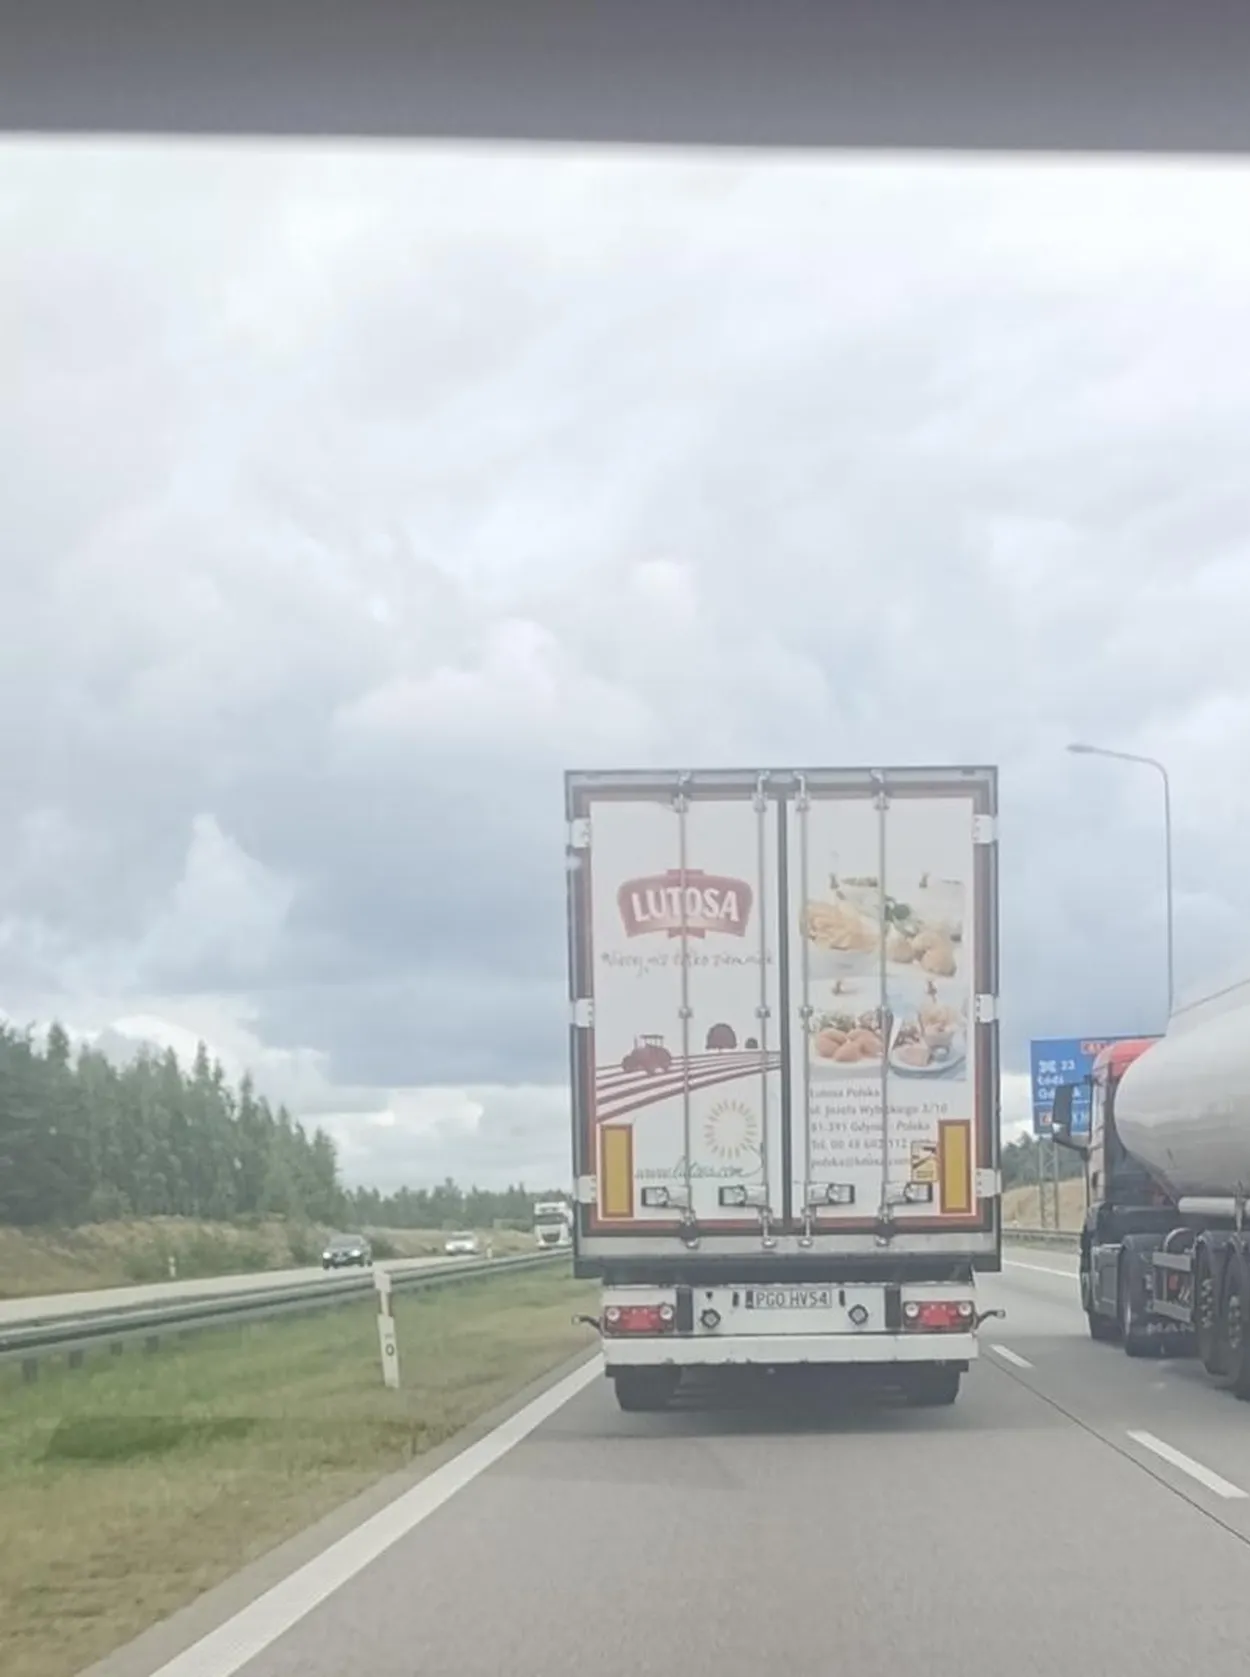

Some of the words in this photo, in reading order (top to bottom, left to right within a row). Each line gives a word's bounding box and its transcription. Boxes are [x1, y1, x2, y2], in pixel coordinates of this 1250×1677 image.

[631, 886, 740, 923] LUTOSA
[846, 1087, 880, 1098] Polska
[859, 1104, 919, 1118] Wybkiego
